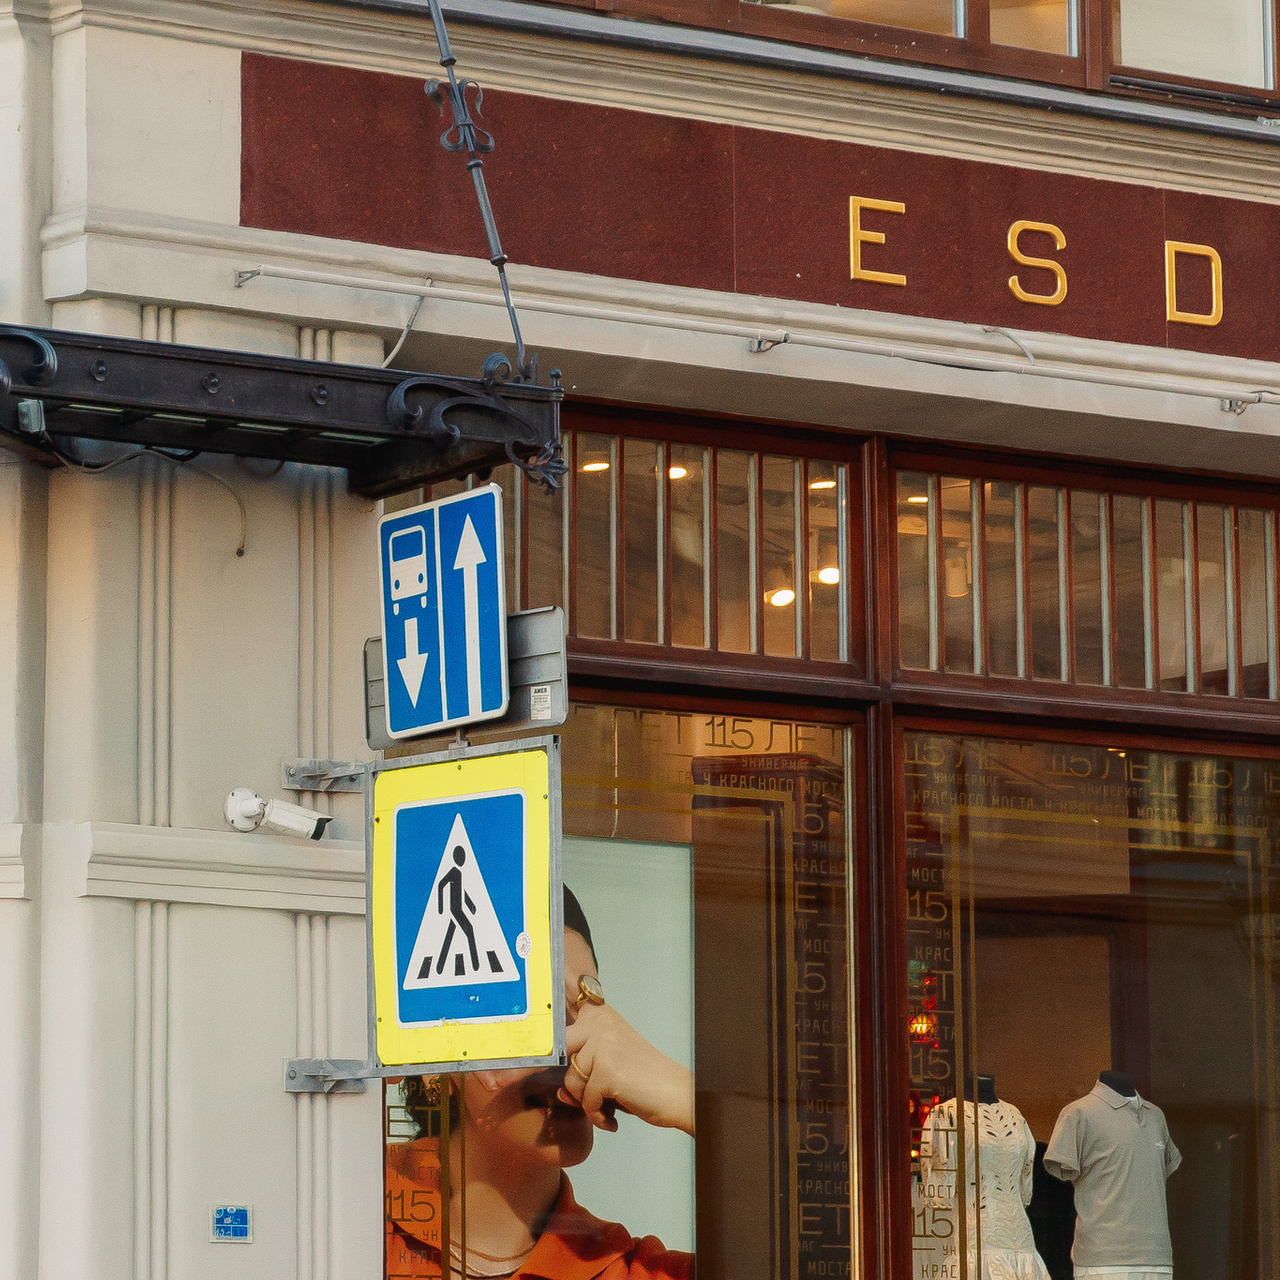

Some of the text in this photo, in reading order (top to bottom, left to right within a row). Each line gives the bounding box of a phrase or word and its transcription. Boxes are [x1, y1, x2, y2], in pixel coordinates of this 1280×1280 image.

[704, 715, 755, 751] 115
[720, 773, 795, 793] КРАСНОГО
[387, 1188, 437, 1223] 115
